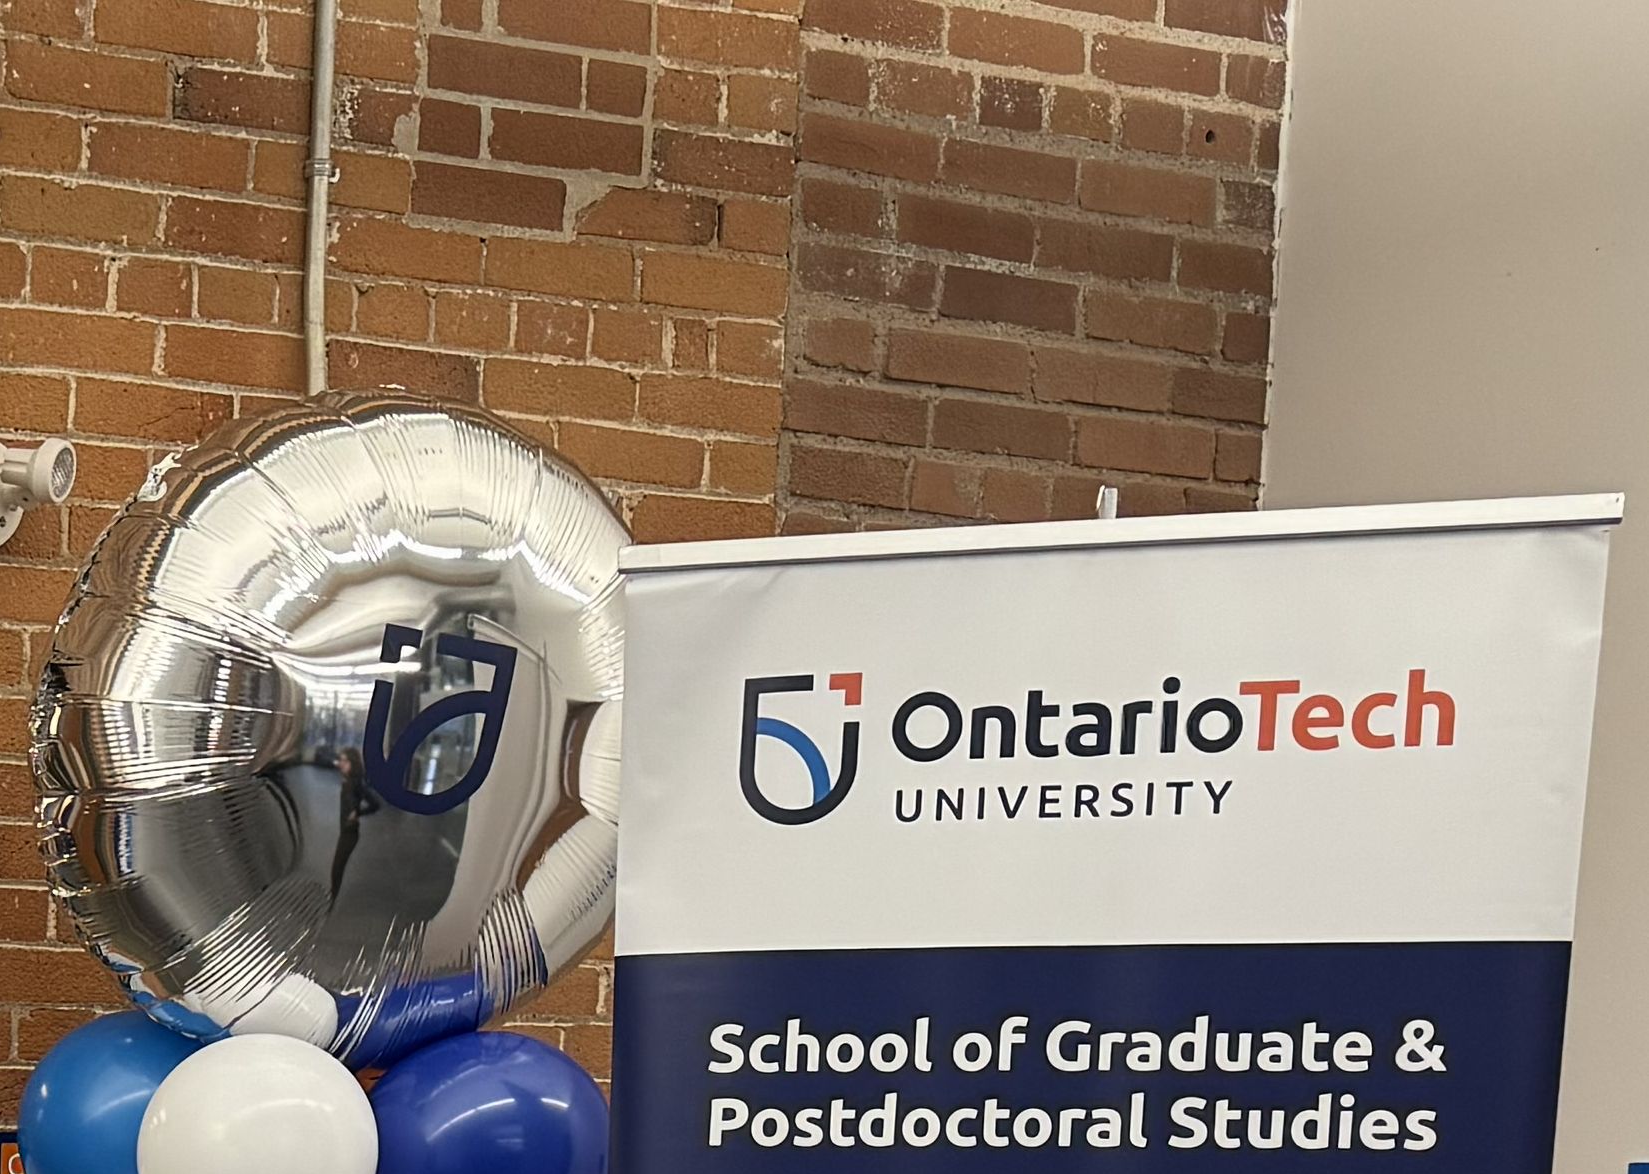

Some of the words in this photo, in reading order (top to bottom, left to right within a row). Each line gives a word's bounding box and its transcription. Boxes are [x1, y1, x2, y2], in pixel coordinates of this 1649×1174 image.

[891, 668, 1457, 763] OntarioTech
[894, 779, 1234, 824] UNIVERSITY
[707, 1018, 933, 1076] School
[952, 1015, 1028, 1075] of
[1045, 1015, 1373, 1075] Graduate
[1395, 1017, 1447, 1074] &
[707, 1092, 1148, 1152] Postdoctoral
[1168, 1092, 1439, 1152] Studies
